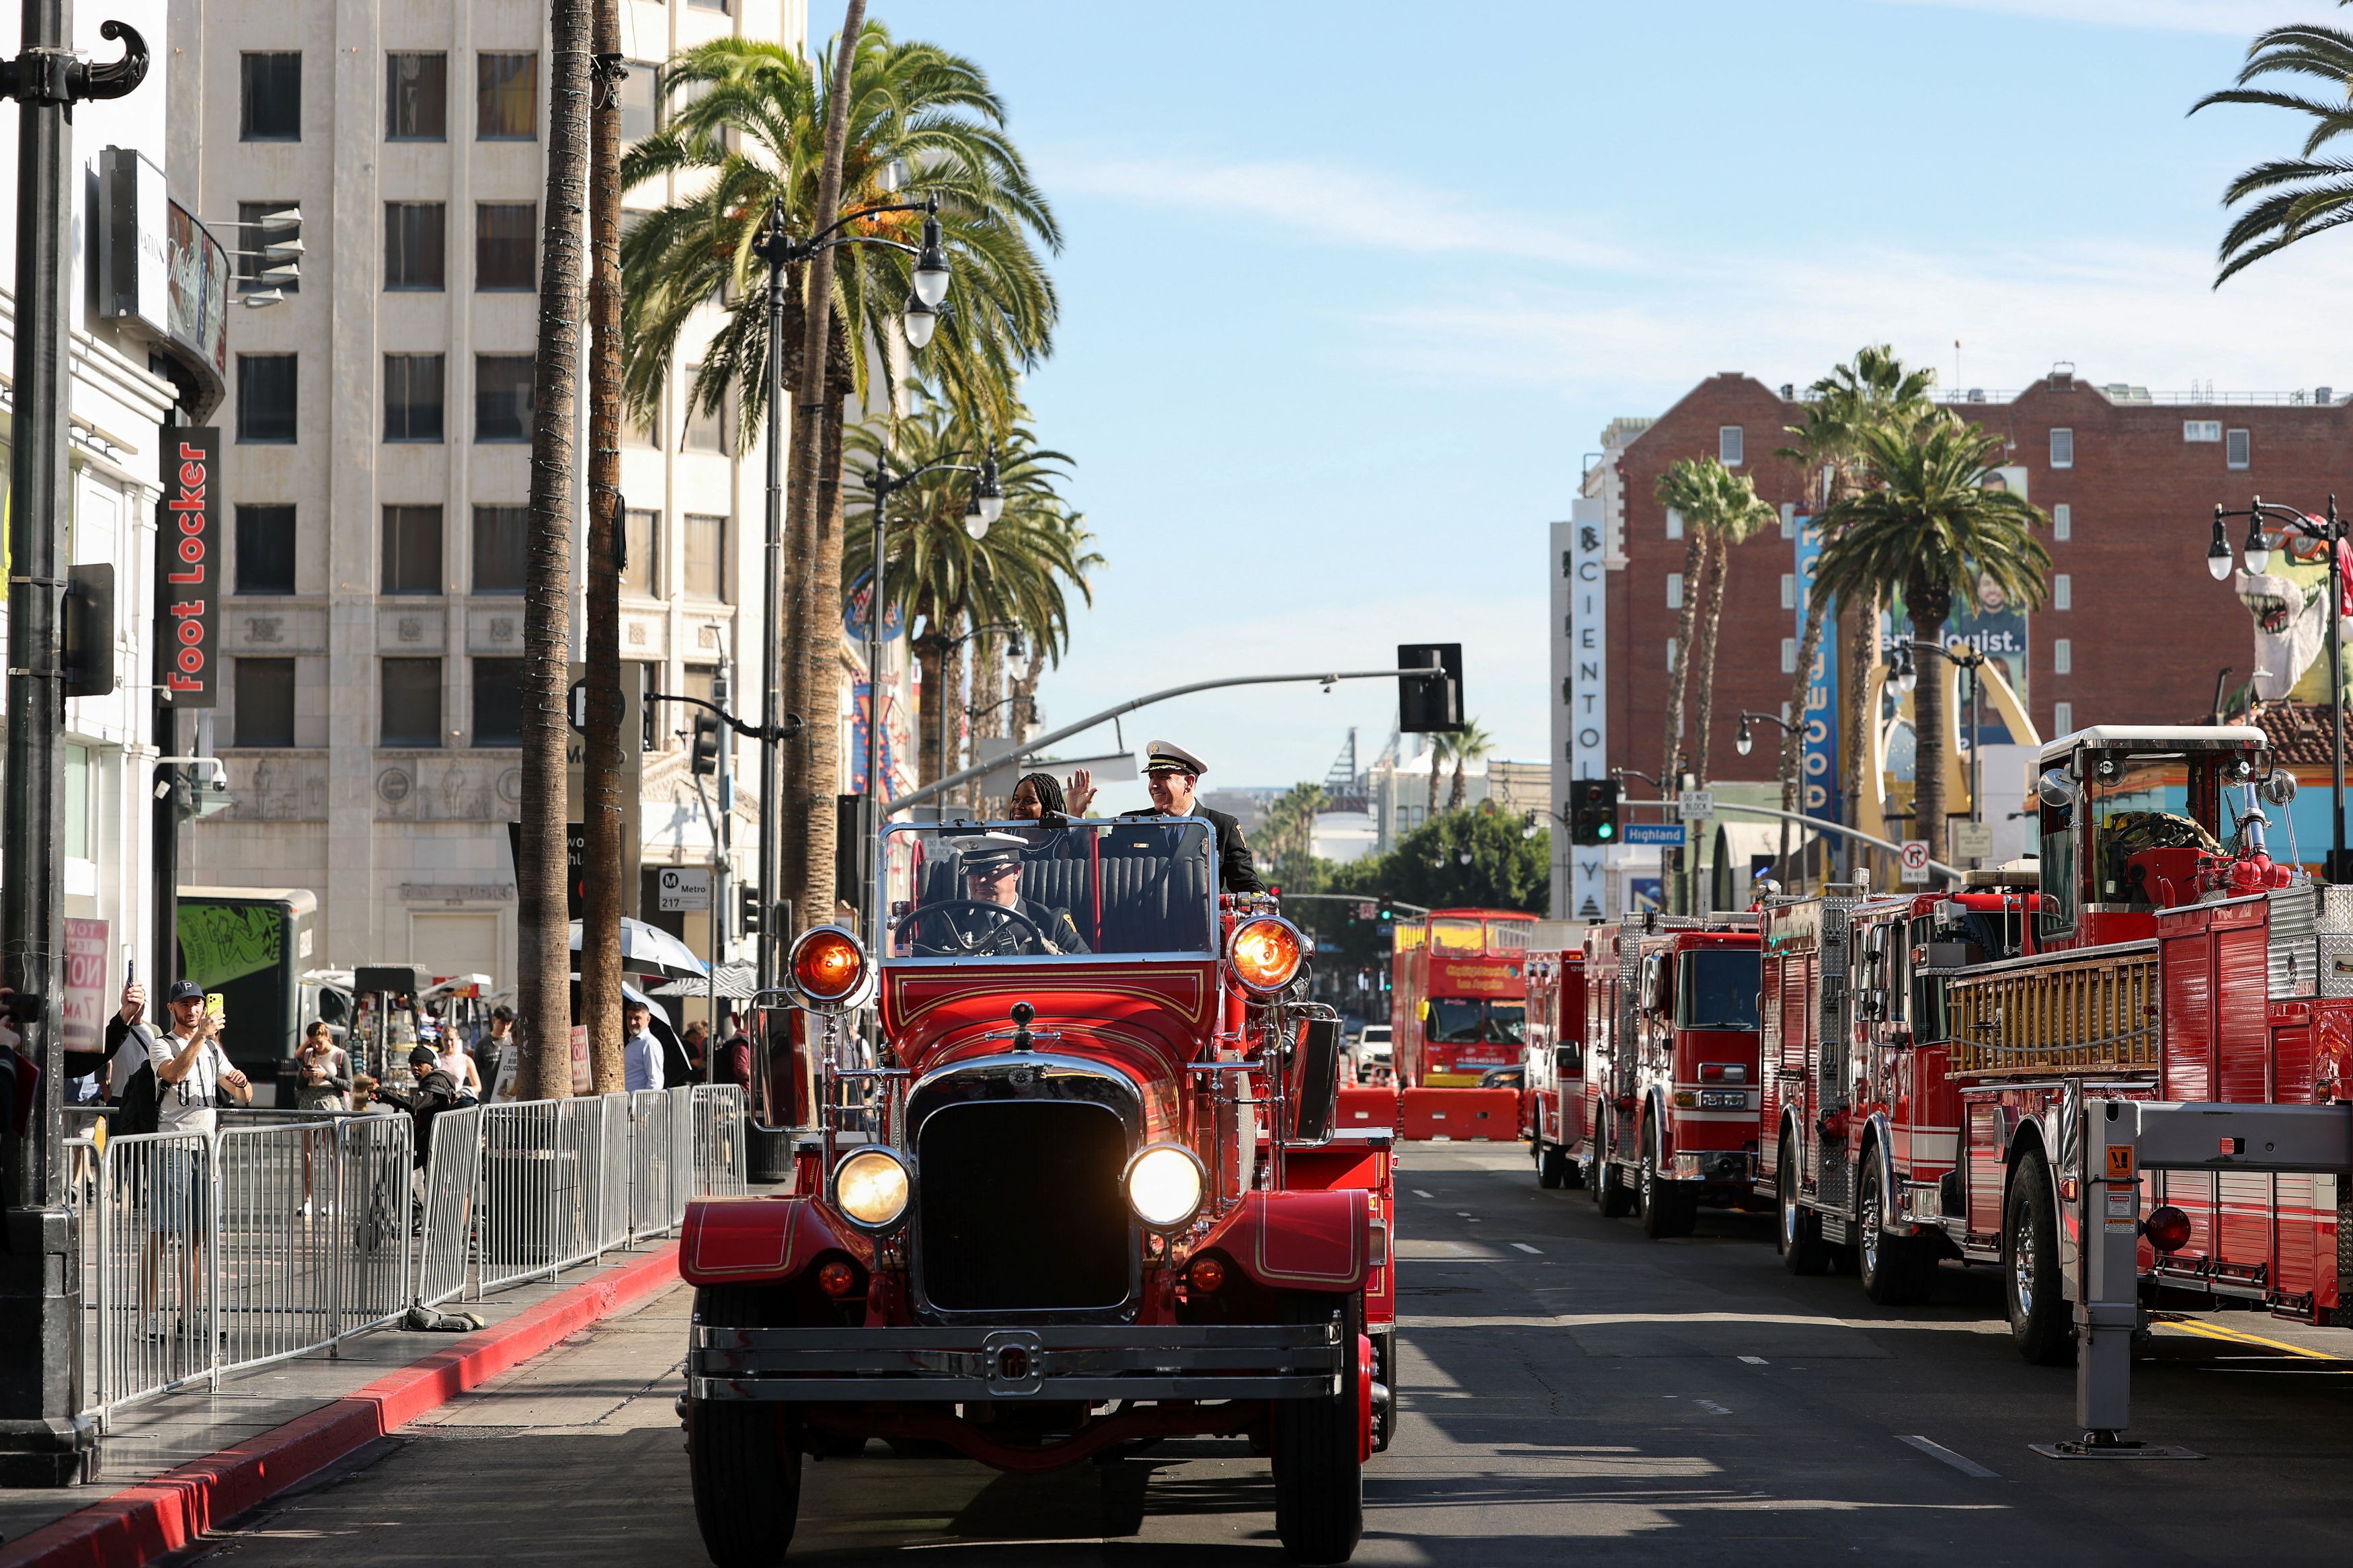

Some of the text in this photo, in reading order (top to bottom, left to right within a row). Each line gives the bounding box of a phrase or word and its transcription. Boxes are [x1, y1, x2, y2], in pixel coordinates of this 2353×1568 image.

[168, 442, 206, 691] Foot Locker
[1629, 829, 1681, 843] Highland
[662, 899, 680, 907] 217
[2295, 981, 2315, 995] NO STEP
